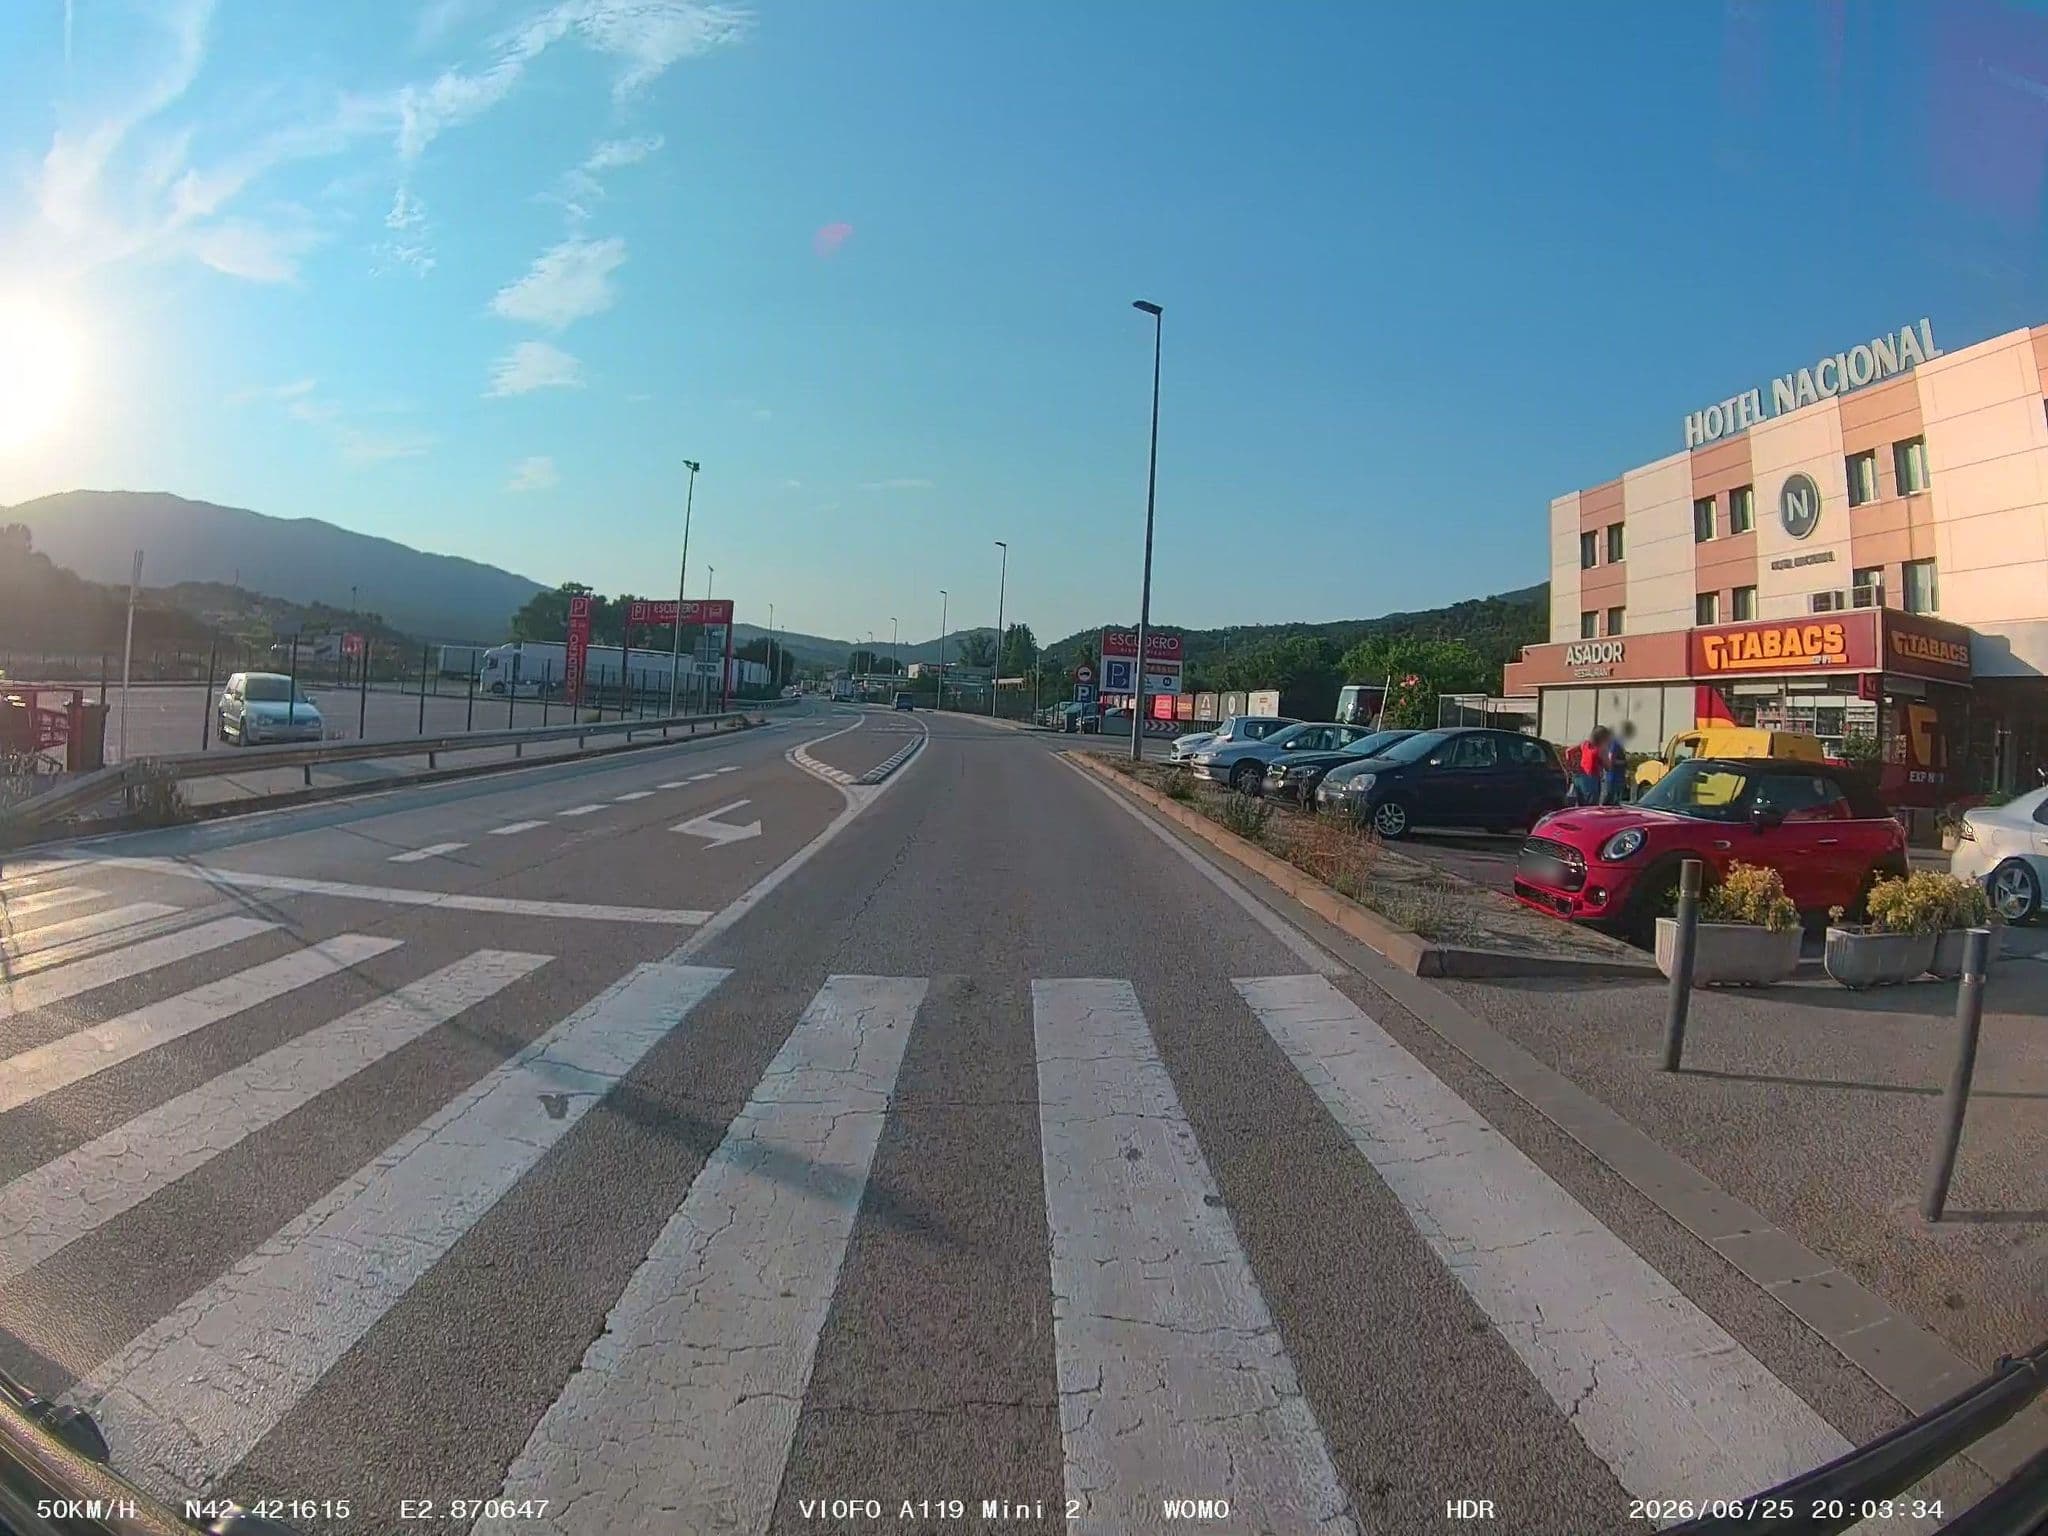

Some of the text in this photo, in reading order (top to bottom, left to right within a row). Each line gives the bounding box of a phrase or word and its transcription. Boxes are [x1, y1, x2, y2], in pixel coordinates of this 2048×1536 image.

[1684, 317, 1943, 448] HOTEL NACIONAL
[1786, 488, 1809, 522] N
[654, 603, 700, 614] ESCUERO
[1565, 640, 1625, 667] ASADOR
[1728, 623, 1846, 660] TABACS
[1908, 634, 1969, 662] TABACS
[1077, 685, 1090, 702] P
